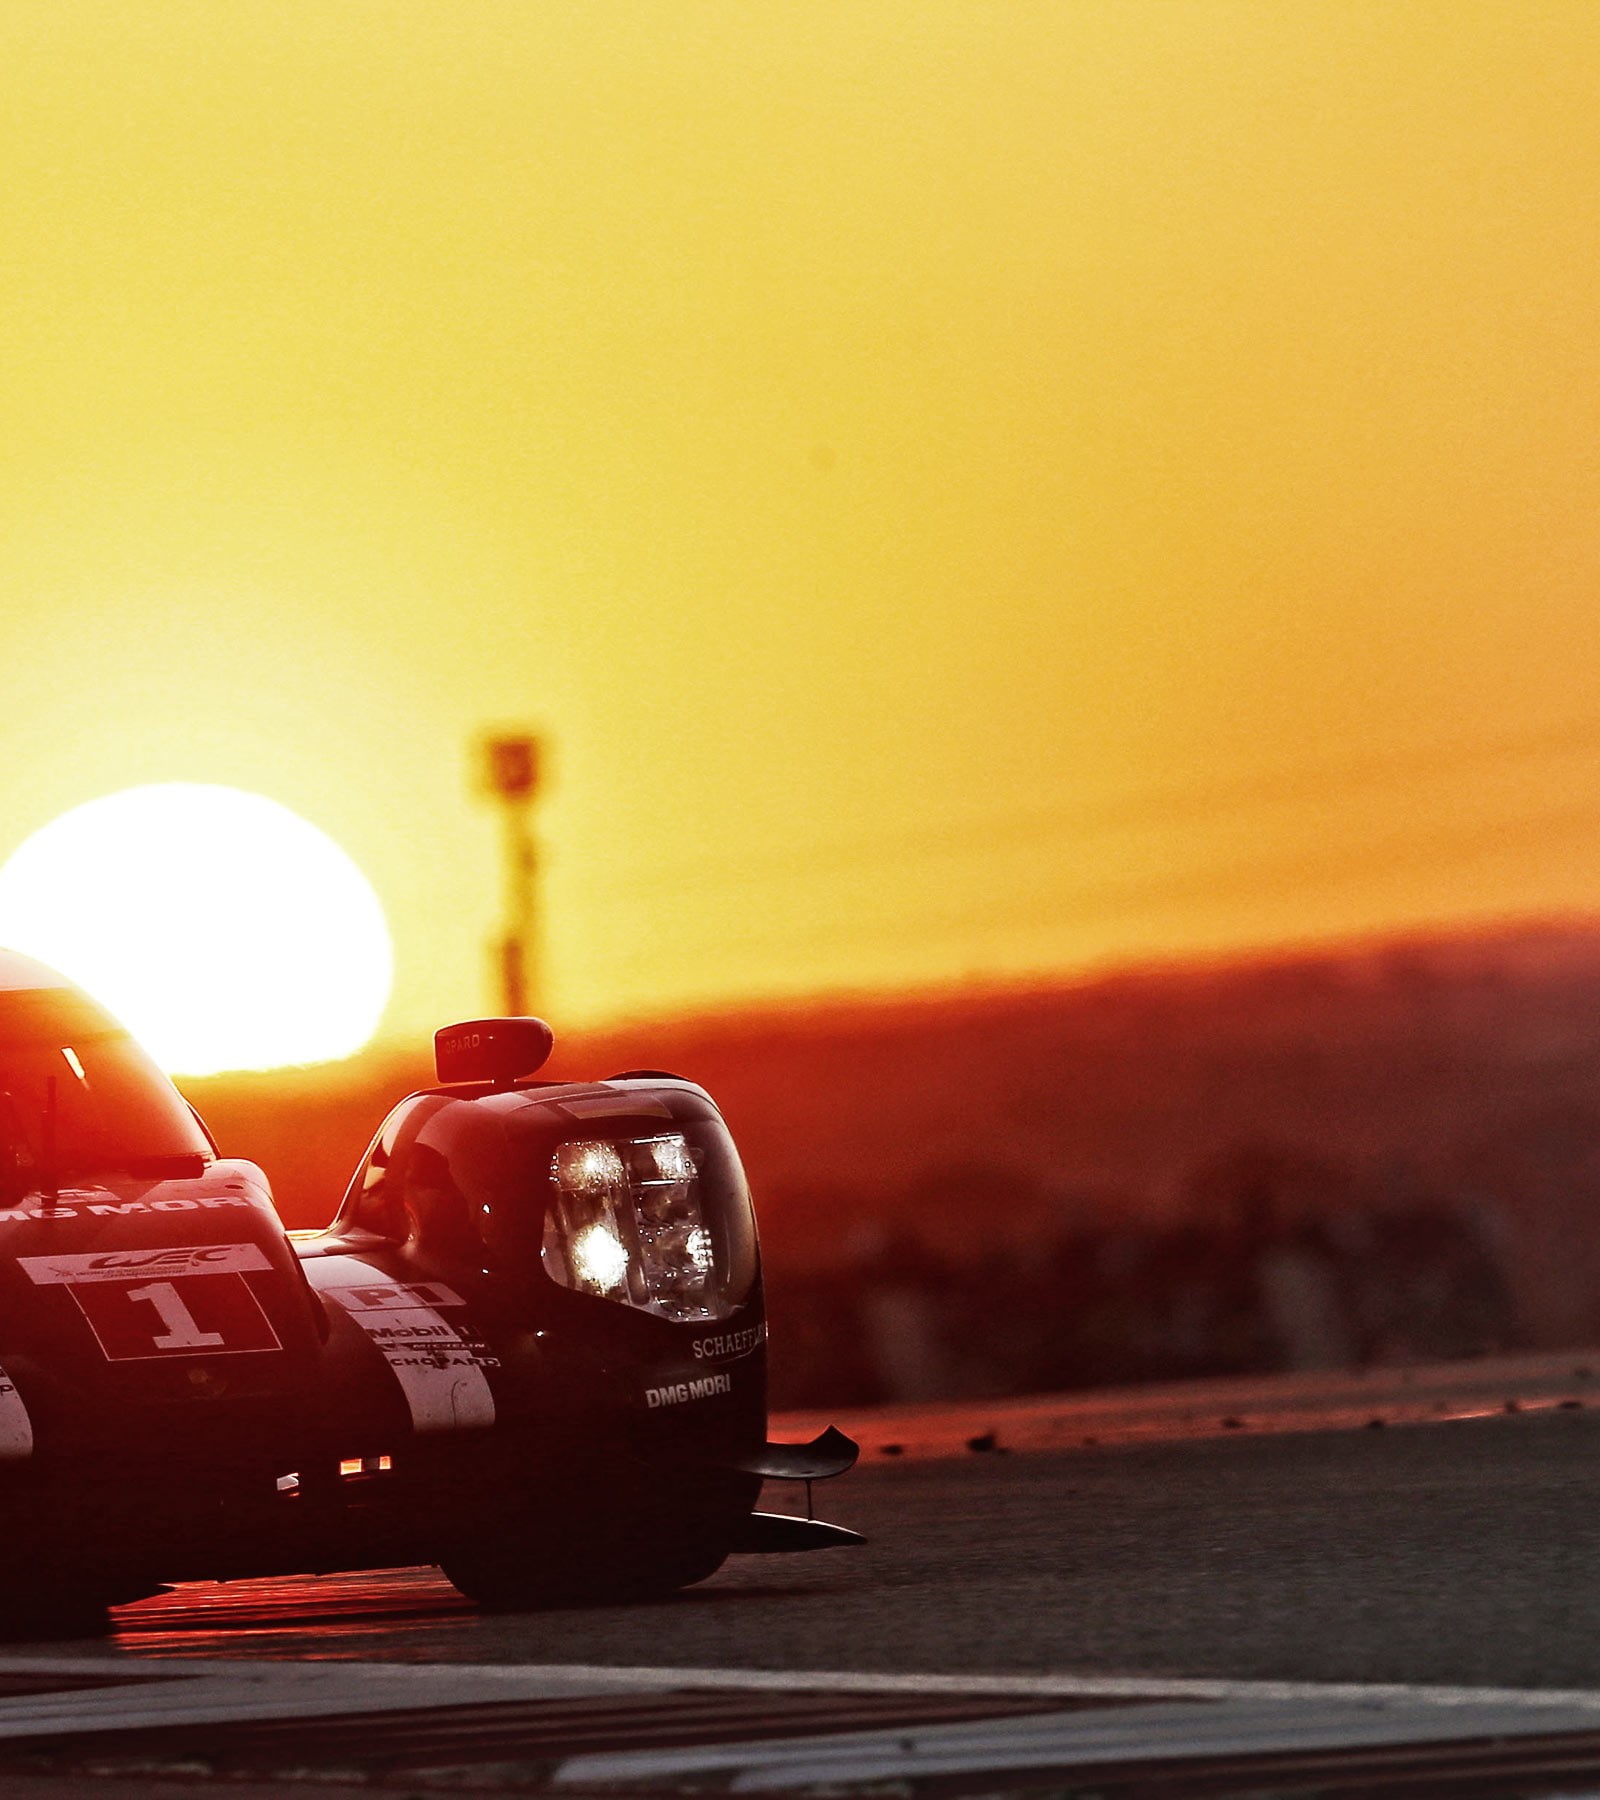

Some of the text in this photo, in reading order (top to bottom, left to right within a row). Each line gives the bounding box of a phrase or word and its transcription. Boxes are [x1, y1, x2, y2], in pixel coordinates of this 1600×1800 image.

[86, 1246, 233, 1270] WEC
[351, 1285, 444, 1306] P1
[126, 1282, 225, 1349] 1
[363, 1326, 450, 1339] Mobil
[389, 1356, 499, 1367] CHOPARD
[645, 1373, 731, 1408] DMG MORI
